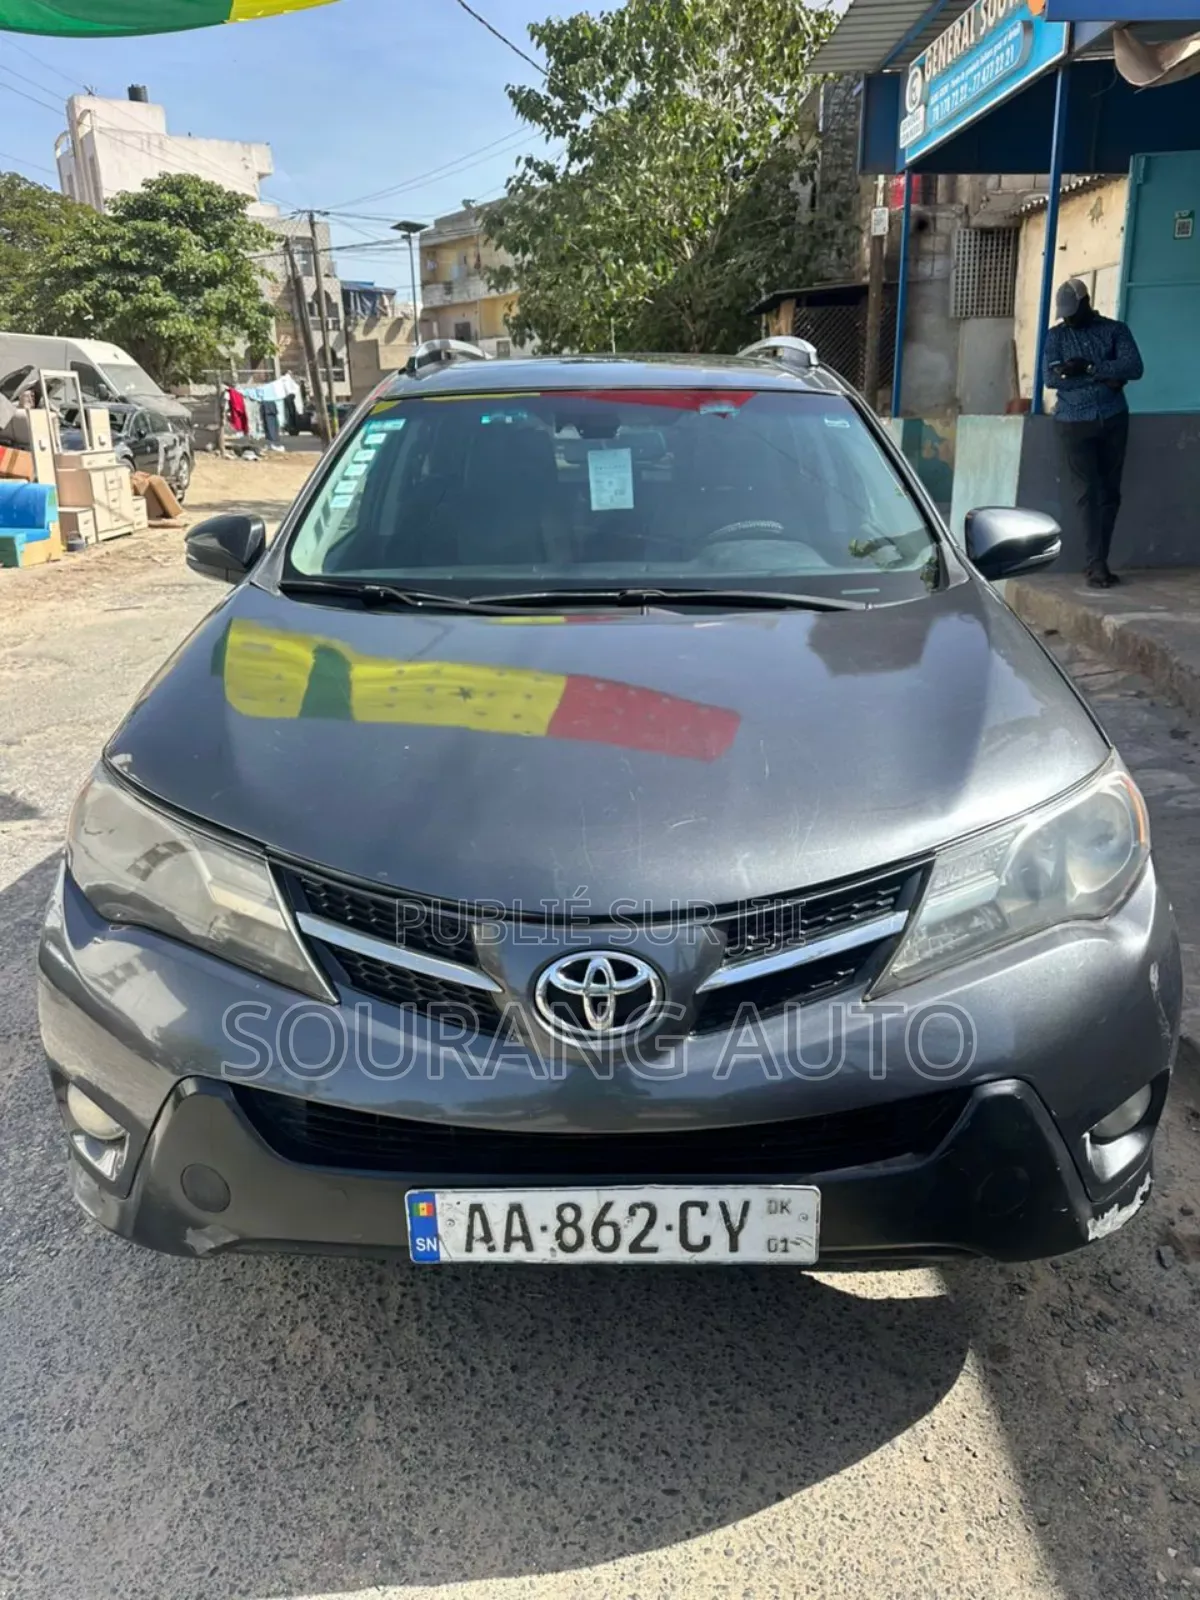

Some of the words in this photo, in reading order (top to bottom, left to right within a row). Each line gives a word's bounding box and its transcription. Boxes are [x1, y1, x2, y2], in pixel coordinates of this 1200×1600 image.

[925, 7, 976, 82] GENERAL
[767, 1199, 792, 1215] DK
[415, 1237, 438, 1252] SN
